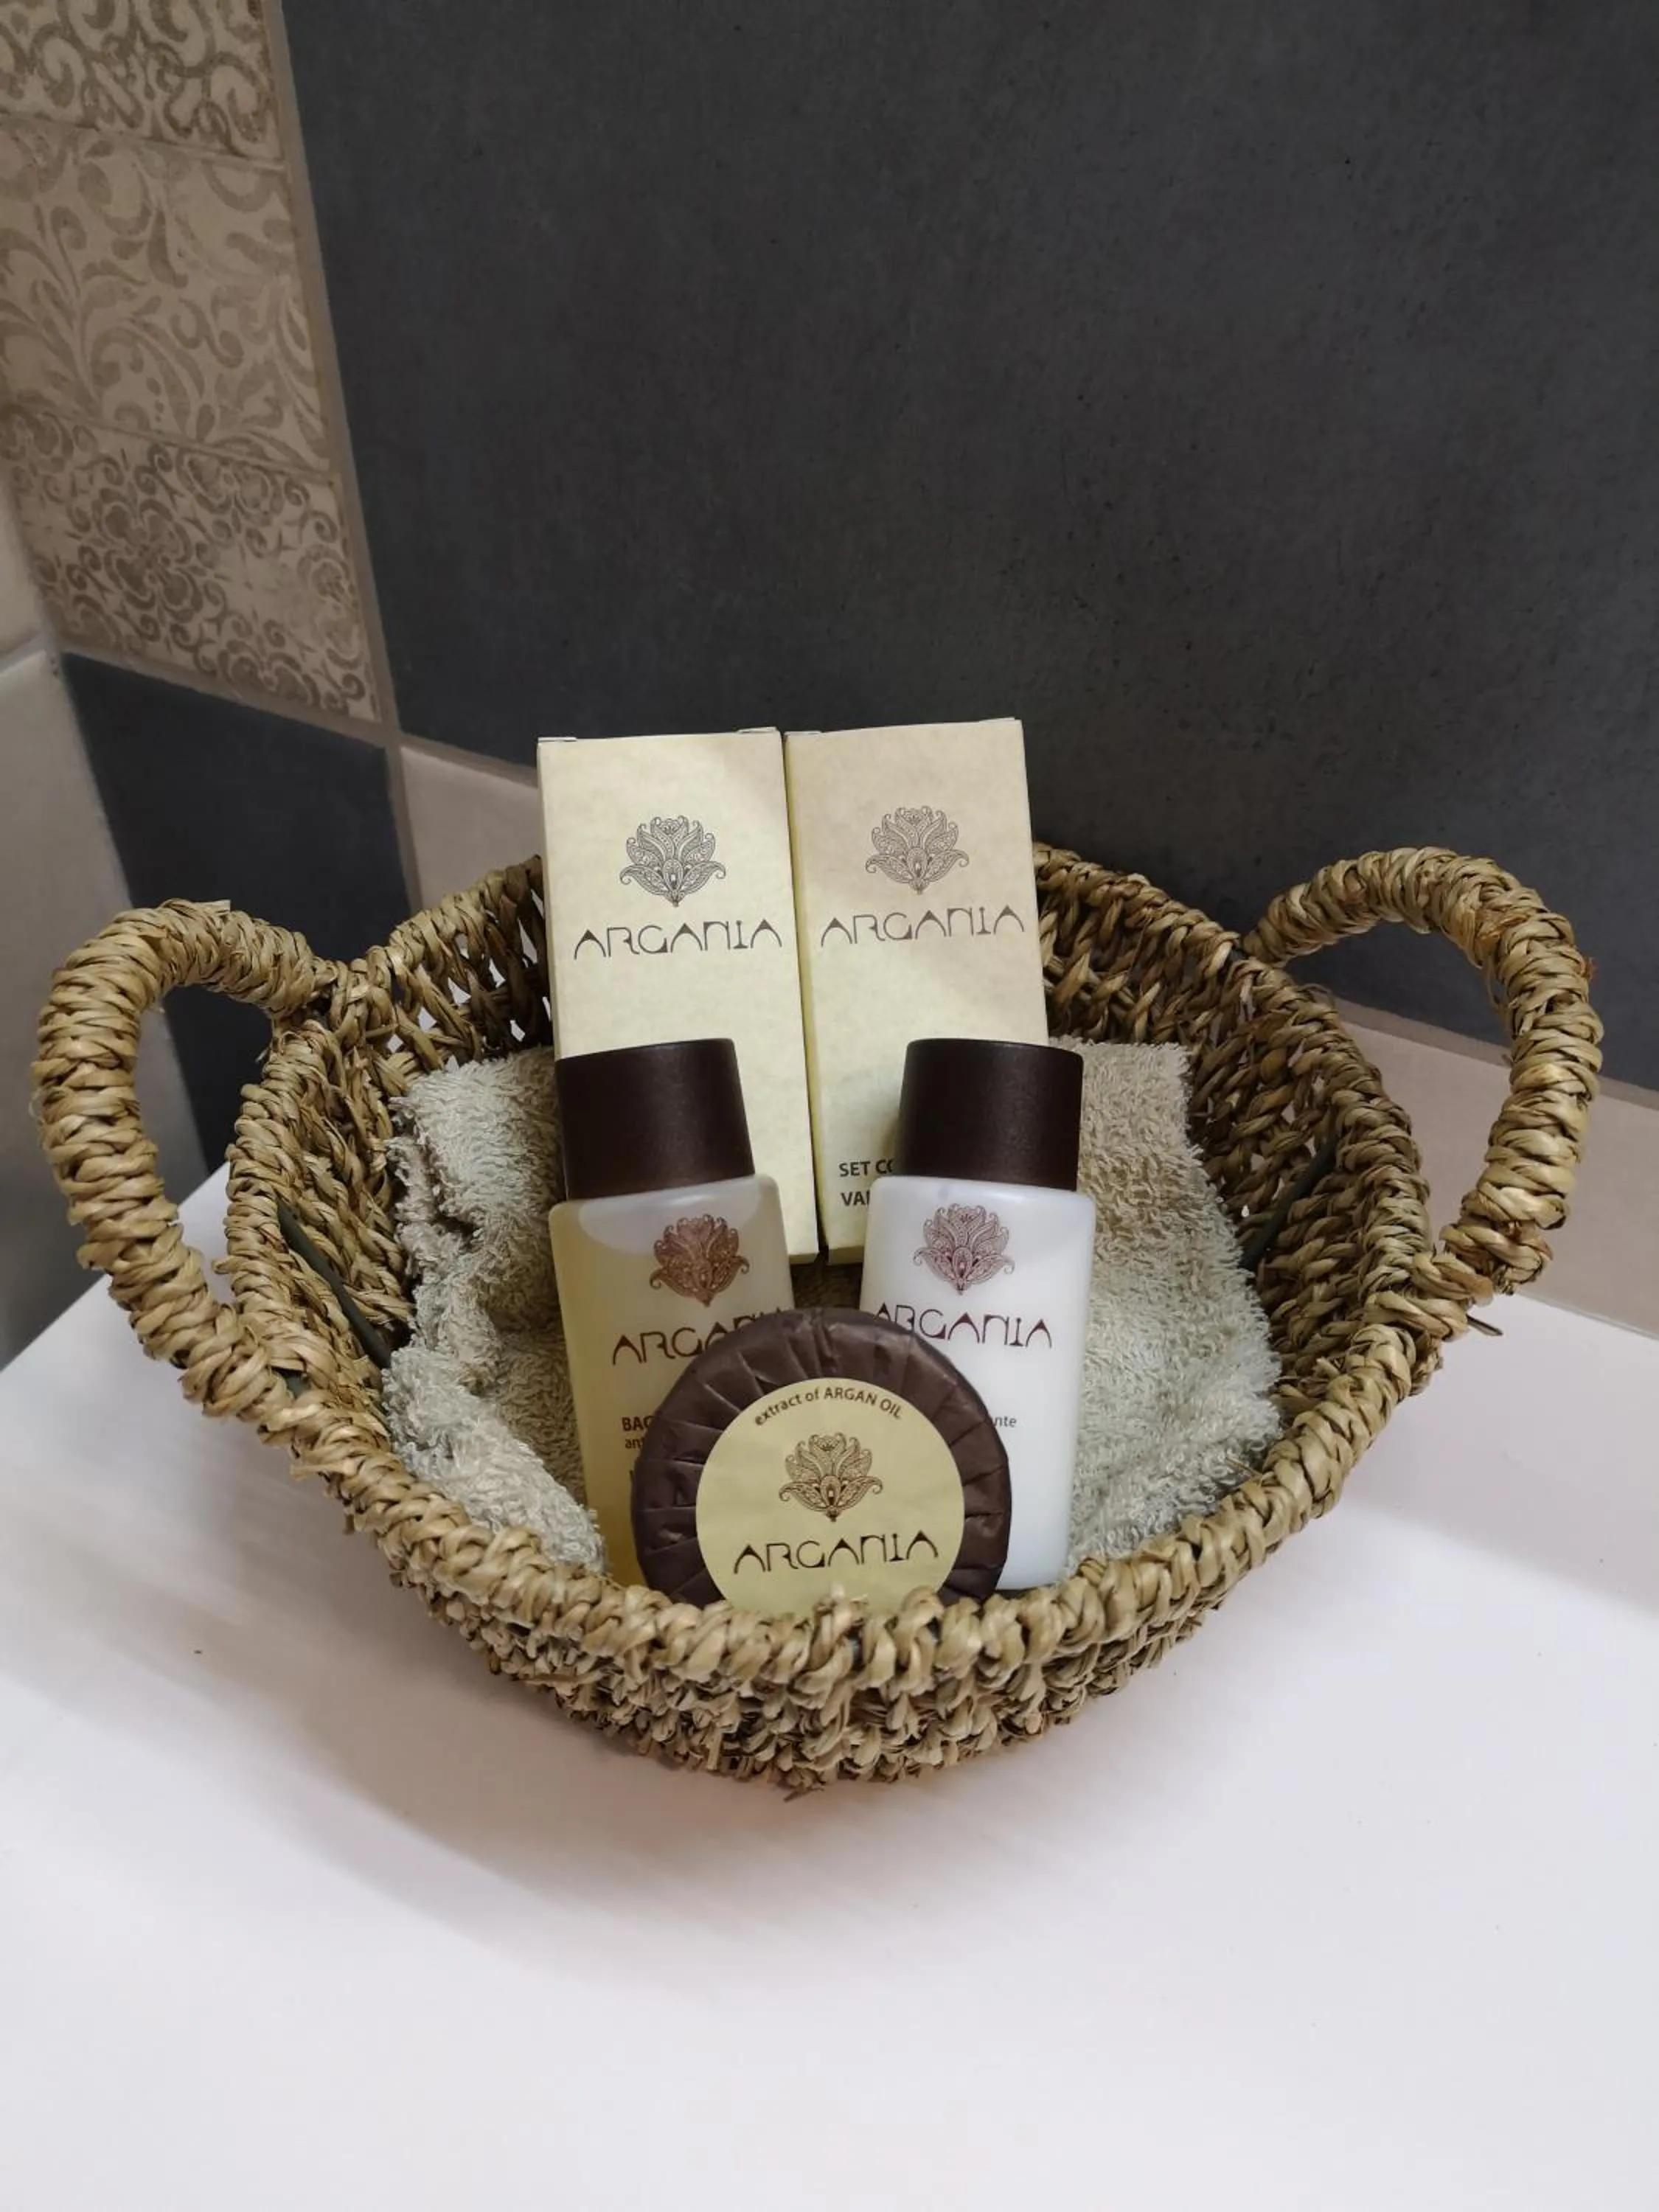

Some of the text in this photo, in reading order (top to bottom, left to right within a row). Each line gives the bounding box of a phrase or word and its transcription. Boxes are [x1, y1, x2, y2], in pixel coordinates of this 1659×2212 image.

[574, 919, 782, 960] ARGANIA
[821, 905, 1025, 947] ARGANIA
[838, 1161, 871, 1177] SET
[754, 1386, 904, 1426] extract of ARGAN OIL
[734, 1529, 939, 1574] ARGANIA
